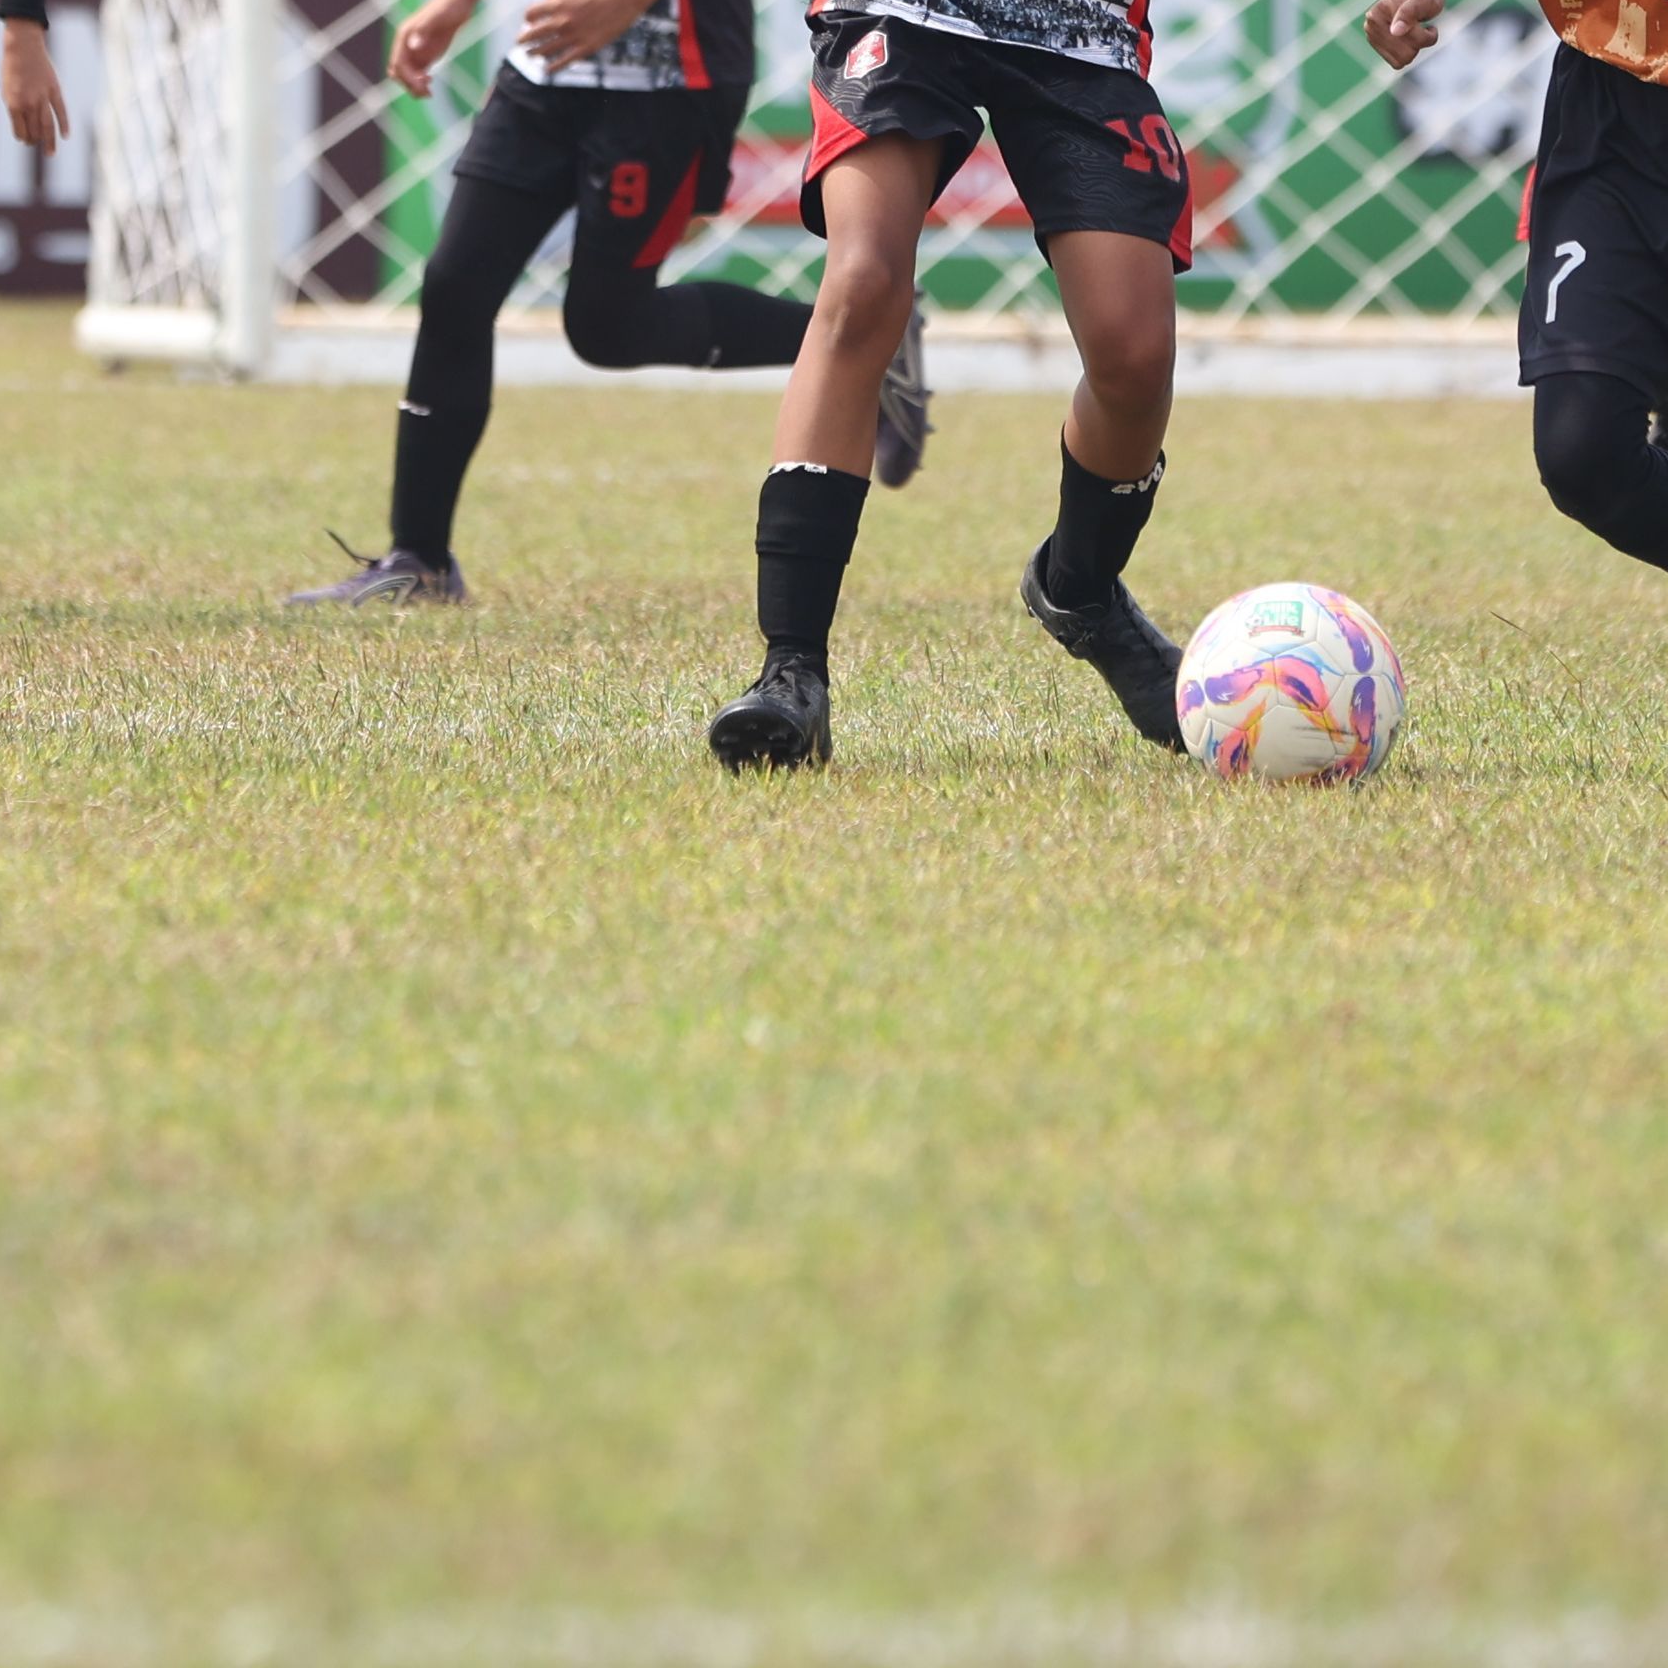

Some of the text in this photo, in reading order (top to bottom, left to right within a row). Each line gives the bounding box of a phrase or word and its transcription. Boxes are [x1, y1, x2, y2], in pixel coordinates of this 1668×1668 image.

[1105, 113, 1181, 184] 10
[609, 162, 649, 219] 9
[1545, 240, 1586, 324] 7
